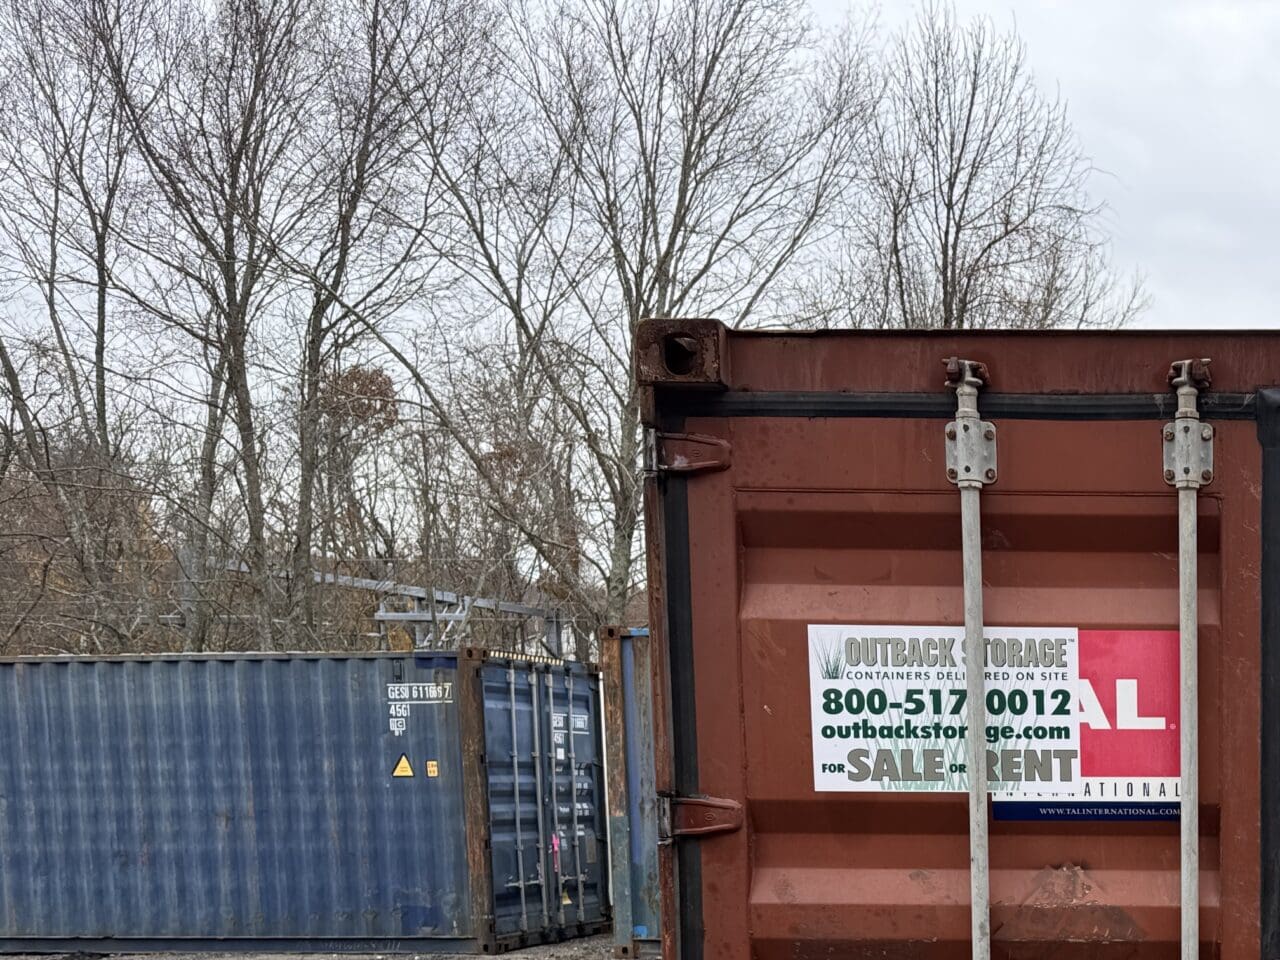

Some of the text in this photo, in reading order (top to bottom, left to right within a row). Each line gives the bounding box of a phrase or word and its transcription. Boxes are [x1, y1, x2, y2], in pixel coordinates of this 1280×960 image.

[845, 637, 957, 667] OUTBACK
[846, 671, 1068, 681] CONTAINERS DELIRED ON SITE
[388, 686, 410, 699] GESU
[822, 688, 1071, 715] 800-5170012
[821, 719, 1070, 743] outbackstorge.com
[822, 748, 1078, 782] FOR SALE OR RENT
